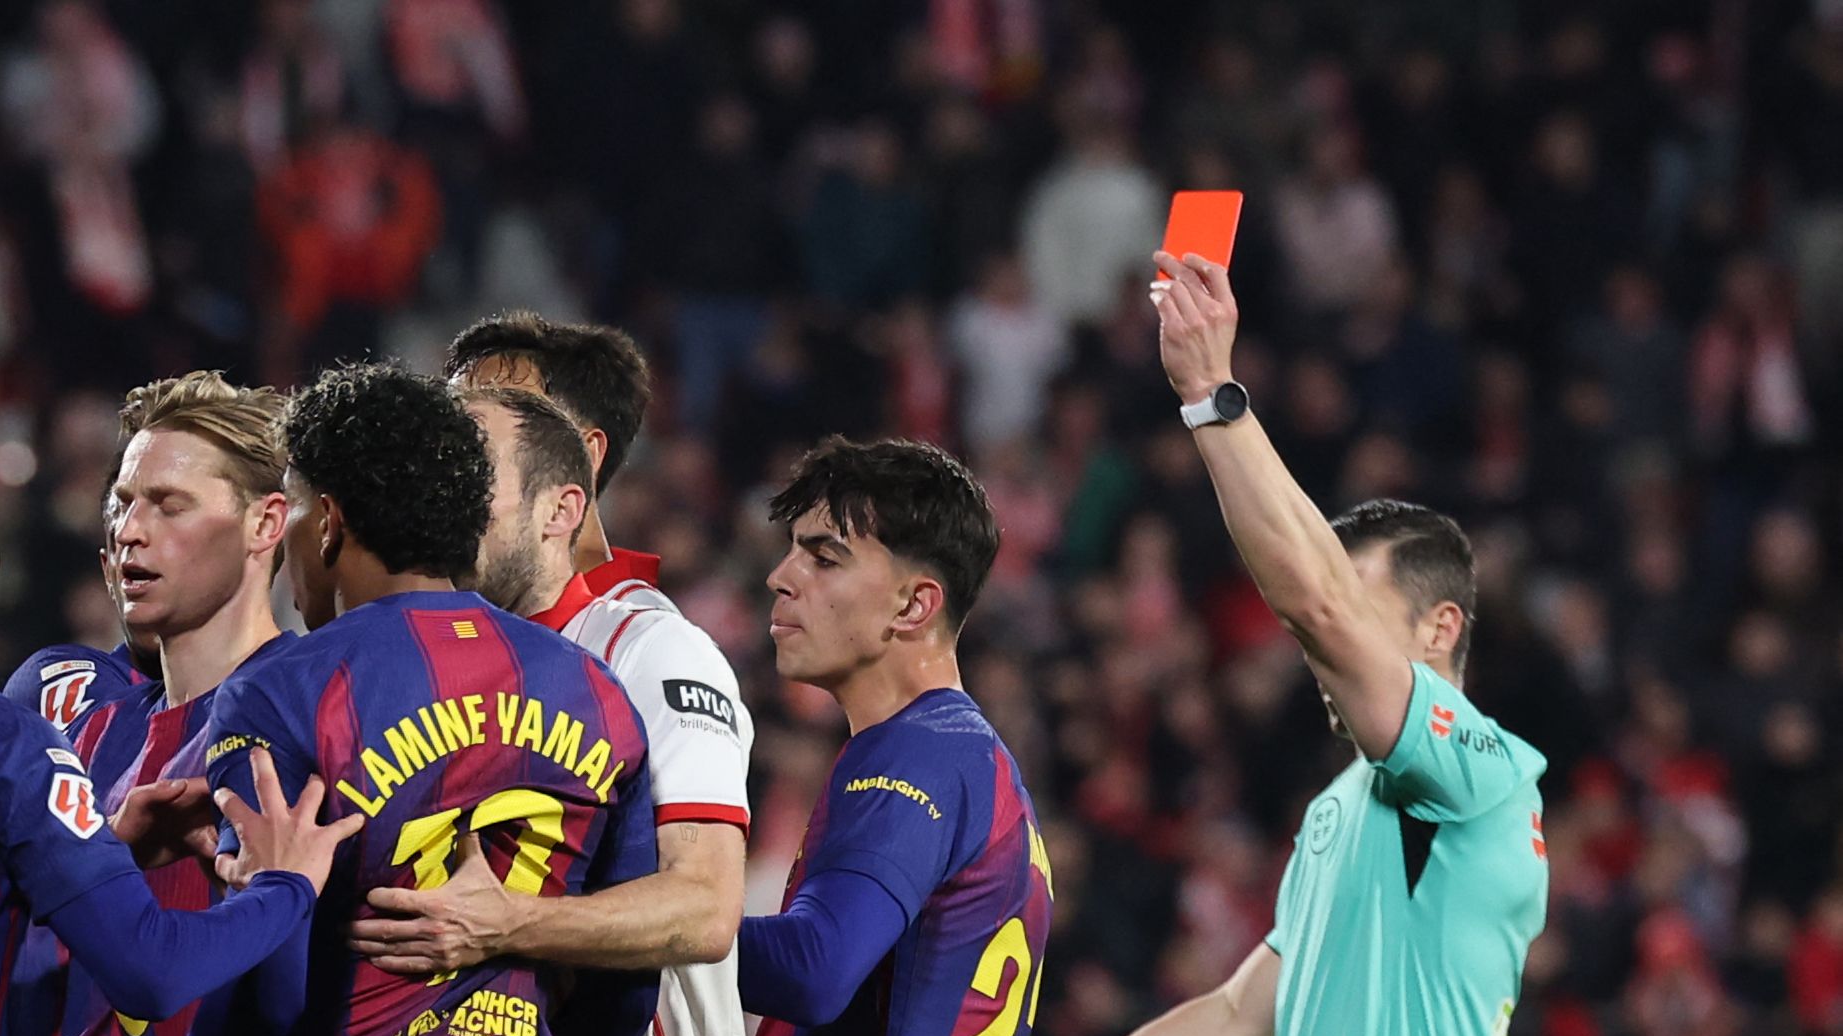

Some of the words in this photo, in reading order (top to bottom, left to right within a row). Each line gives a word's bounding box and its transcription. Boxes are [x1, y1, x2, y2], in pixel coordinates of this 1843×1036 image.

[679, 685, 732, 723] HYLO
[335, 693, 486, 818] LAMINE
[497, 691, 625, 804] YAMAL
[928, 803, 941, 820] tv
